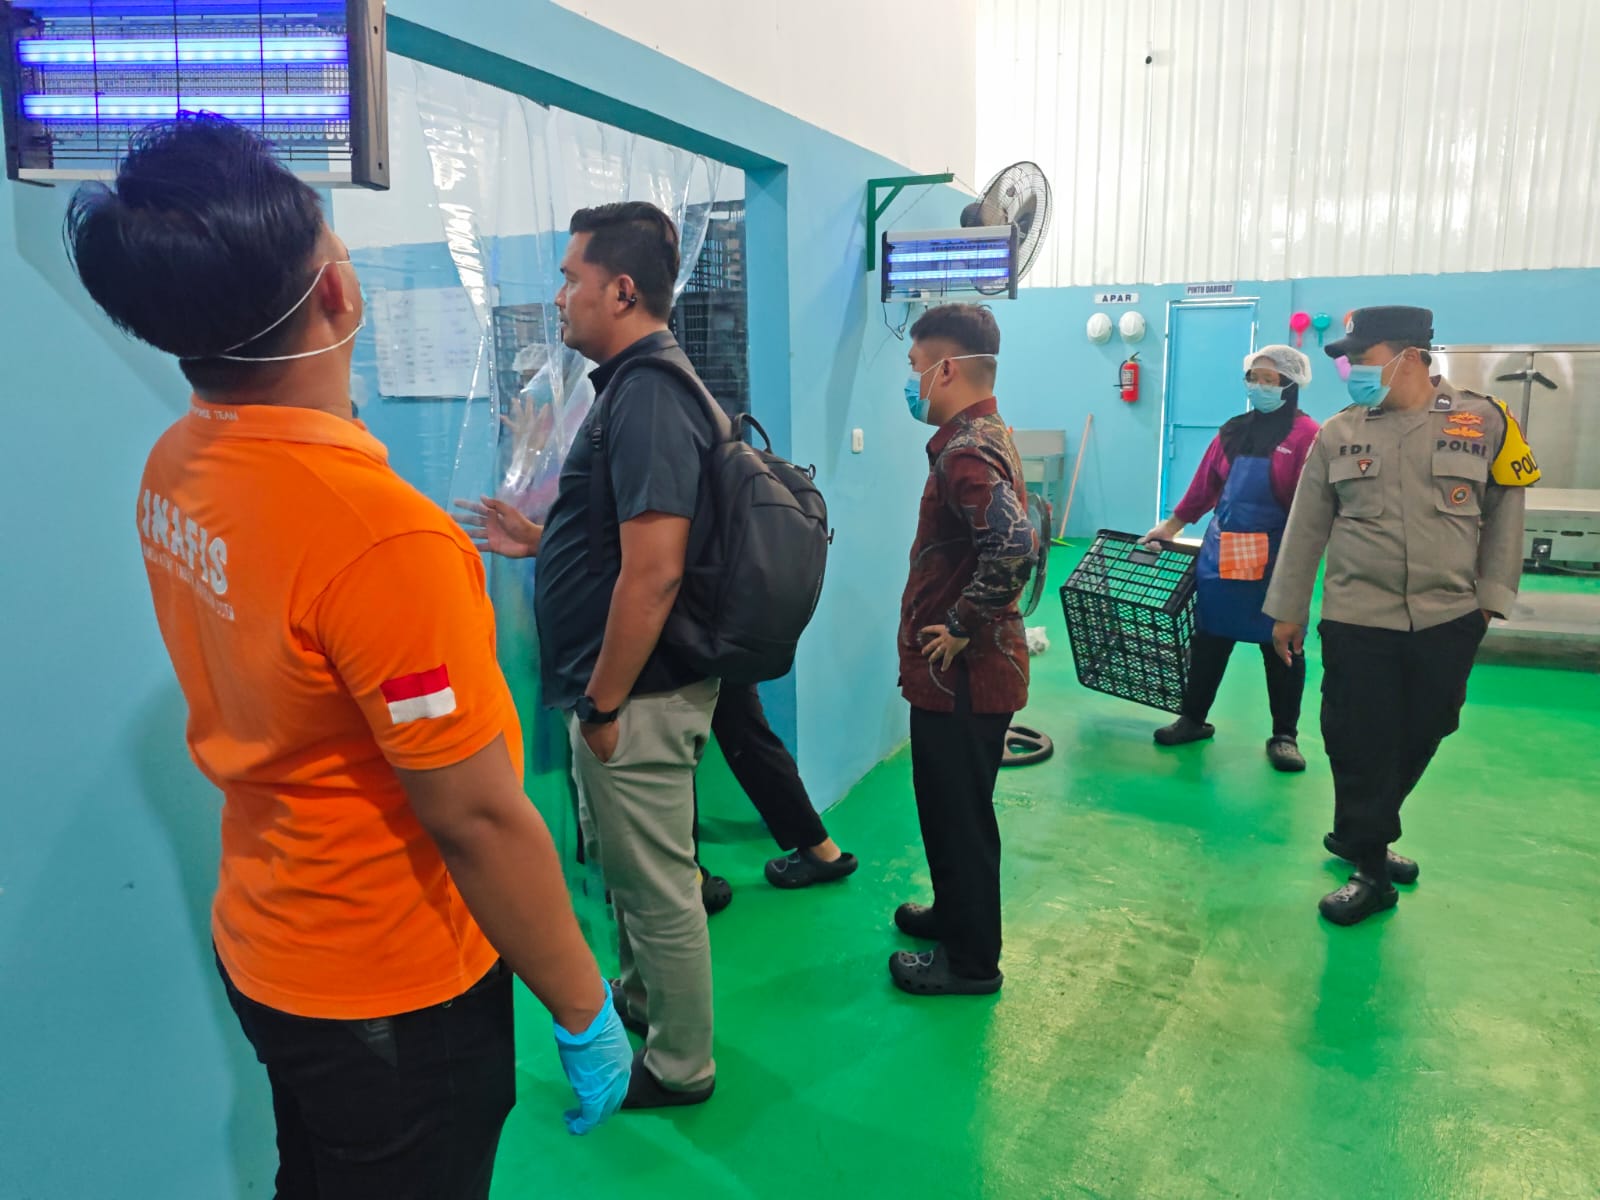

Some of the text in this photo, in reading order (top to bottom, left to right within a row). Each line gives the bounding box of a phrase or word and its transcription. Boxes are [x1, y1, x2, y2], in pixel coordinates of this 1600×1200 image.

[1187, 286, 1204, 294] PINTU
[1102, 294, 1132, 303] APAR
[1339, 444, 1371, 456] EDI
[1436, 440, 1486, 456] POLRI
[142, 489, 228, 595] INAFIS
